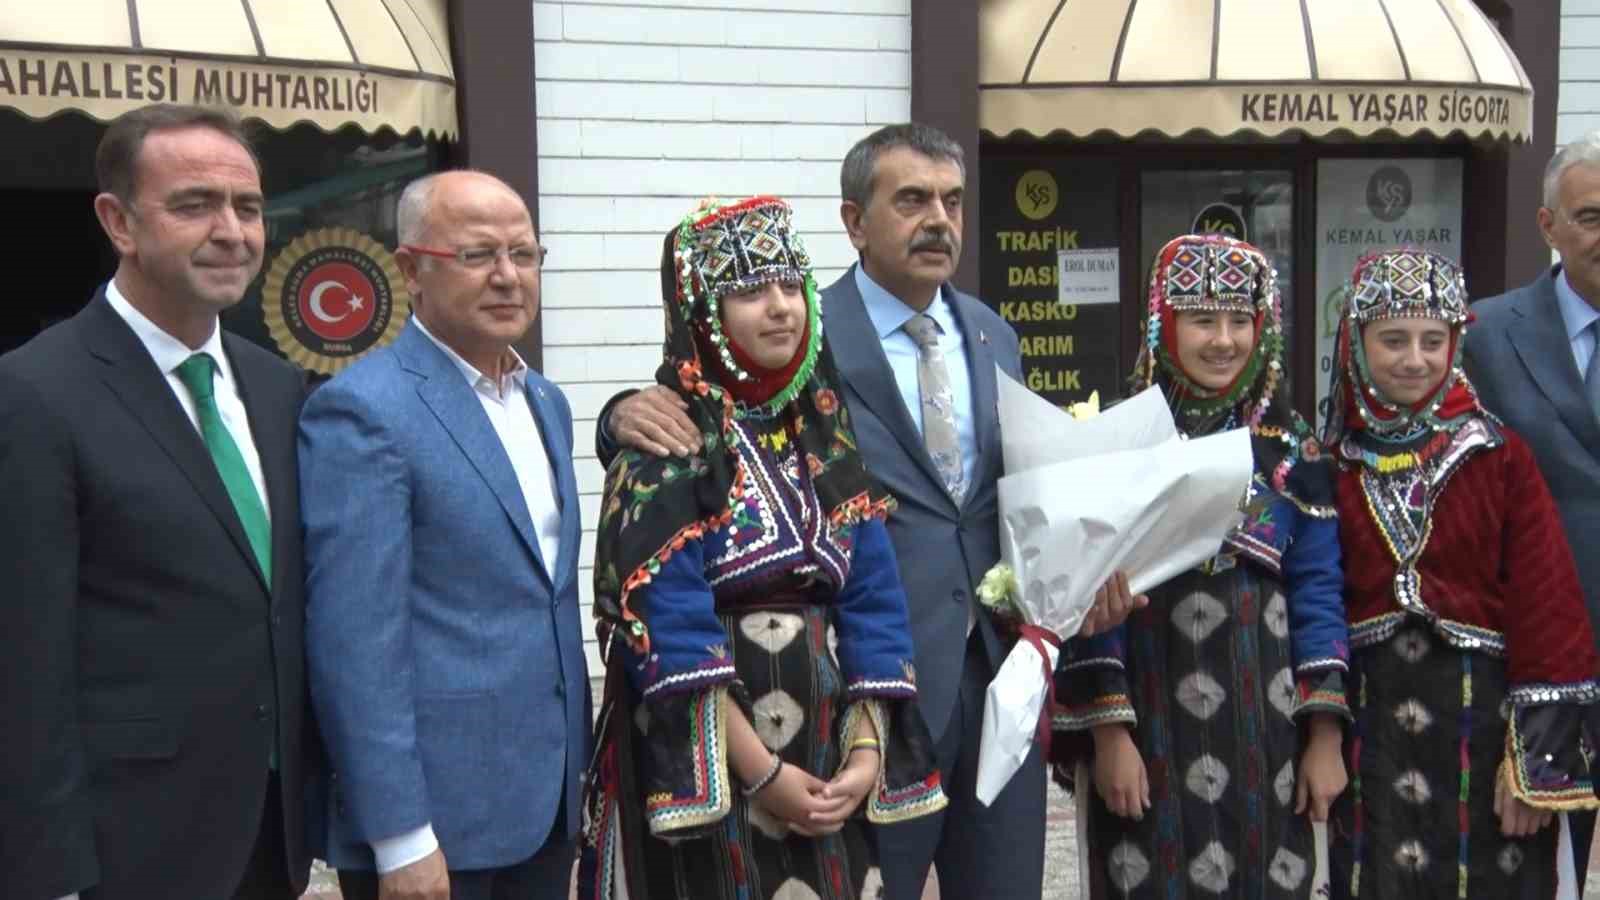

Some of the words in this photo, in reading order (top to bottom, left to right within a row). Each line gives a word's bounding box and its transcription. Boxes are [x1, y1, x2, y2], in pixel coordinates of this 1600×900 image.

[194, 68, 377, 113] MUHTARLIĞI
[1241, 93, 1338, 122] KEMAL
[1348, 93, 1428, 126] YAŞAR
[1438, 90, 1510, 125] SİGORTA
[996, 226, 1079, 251] TRAFİK
[1327, 228, 1386, 244] KEMAL
[1000, 301, 1077, 321] KASKO
[1020, 335, 1073, 356] ARIM
[1028, 366, 1080, 391] ĞLIK
